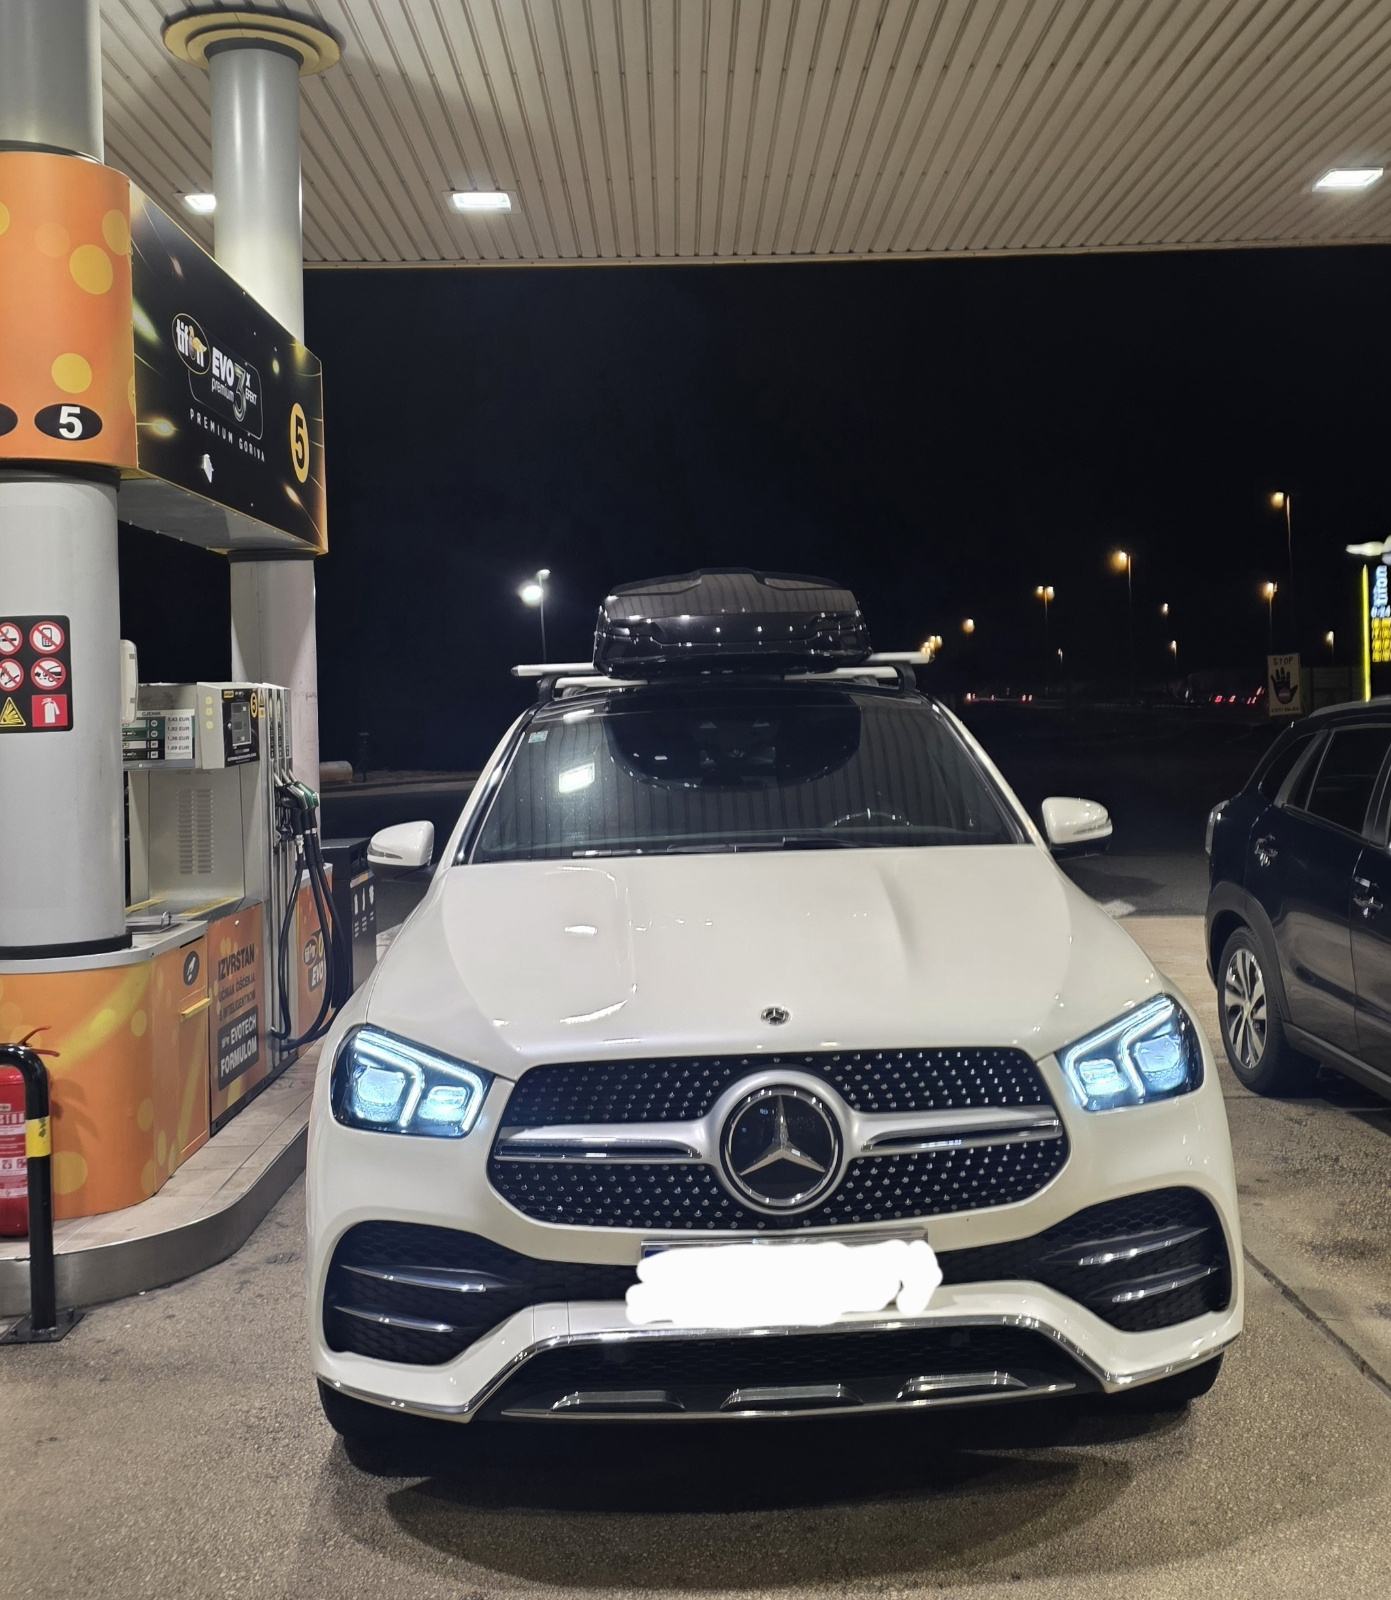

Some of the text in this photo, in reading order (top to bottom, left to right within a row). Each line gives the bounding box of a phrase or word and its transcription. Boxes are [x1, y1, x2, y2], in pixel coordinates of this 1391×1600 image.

[212, 347, 235, 387] EVO
[212, 378, 235, 402] premium
[59, 406, 83, 439] 5
[190, 408, 265, 462] PREMIUM GORIVA
[295, 415, 305, 470] 5
[1272, 655, 1294, 666] STOP
[218, 944, 255, 980] IZVRSTAN
[231, 1013, 257, 1045] EVOTECH
[221, 1036, 257, 1077] FORMULOM
